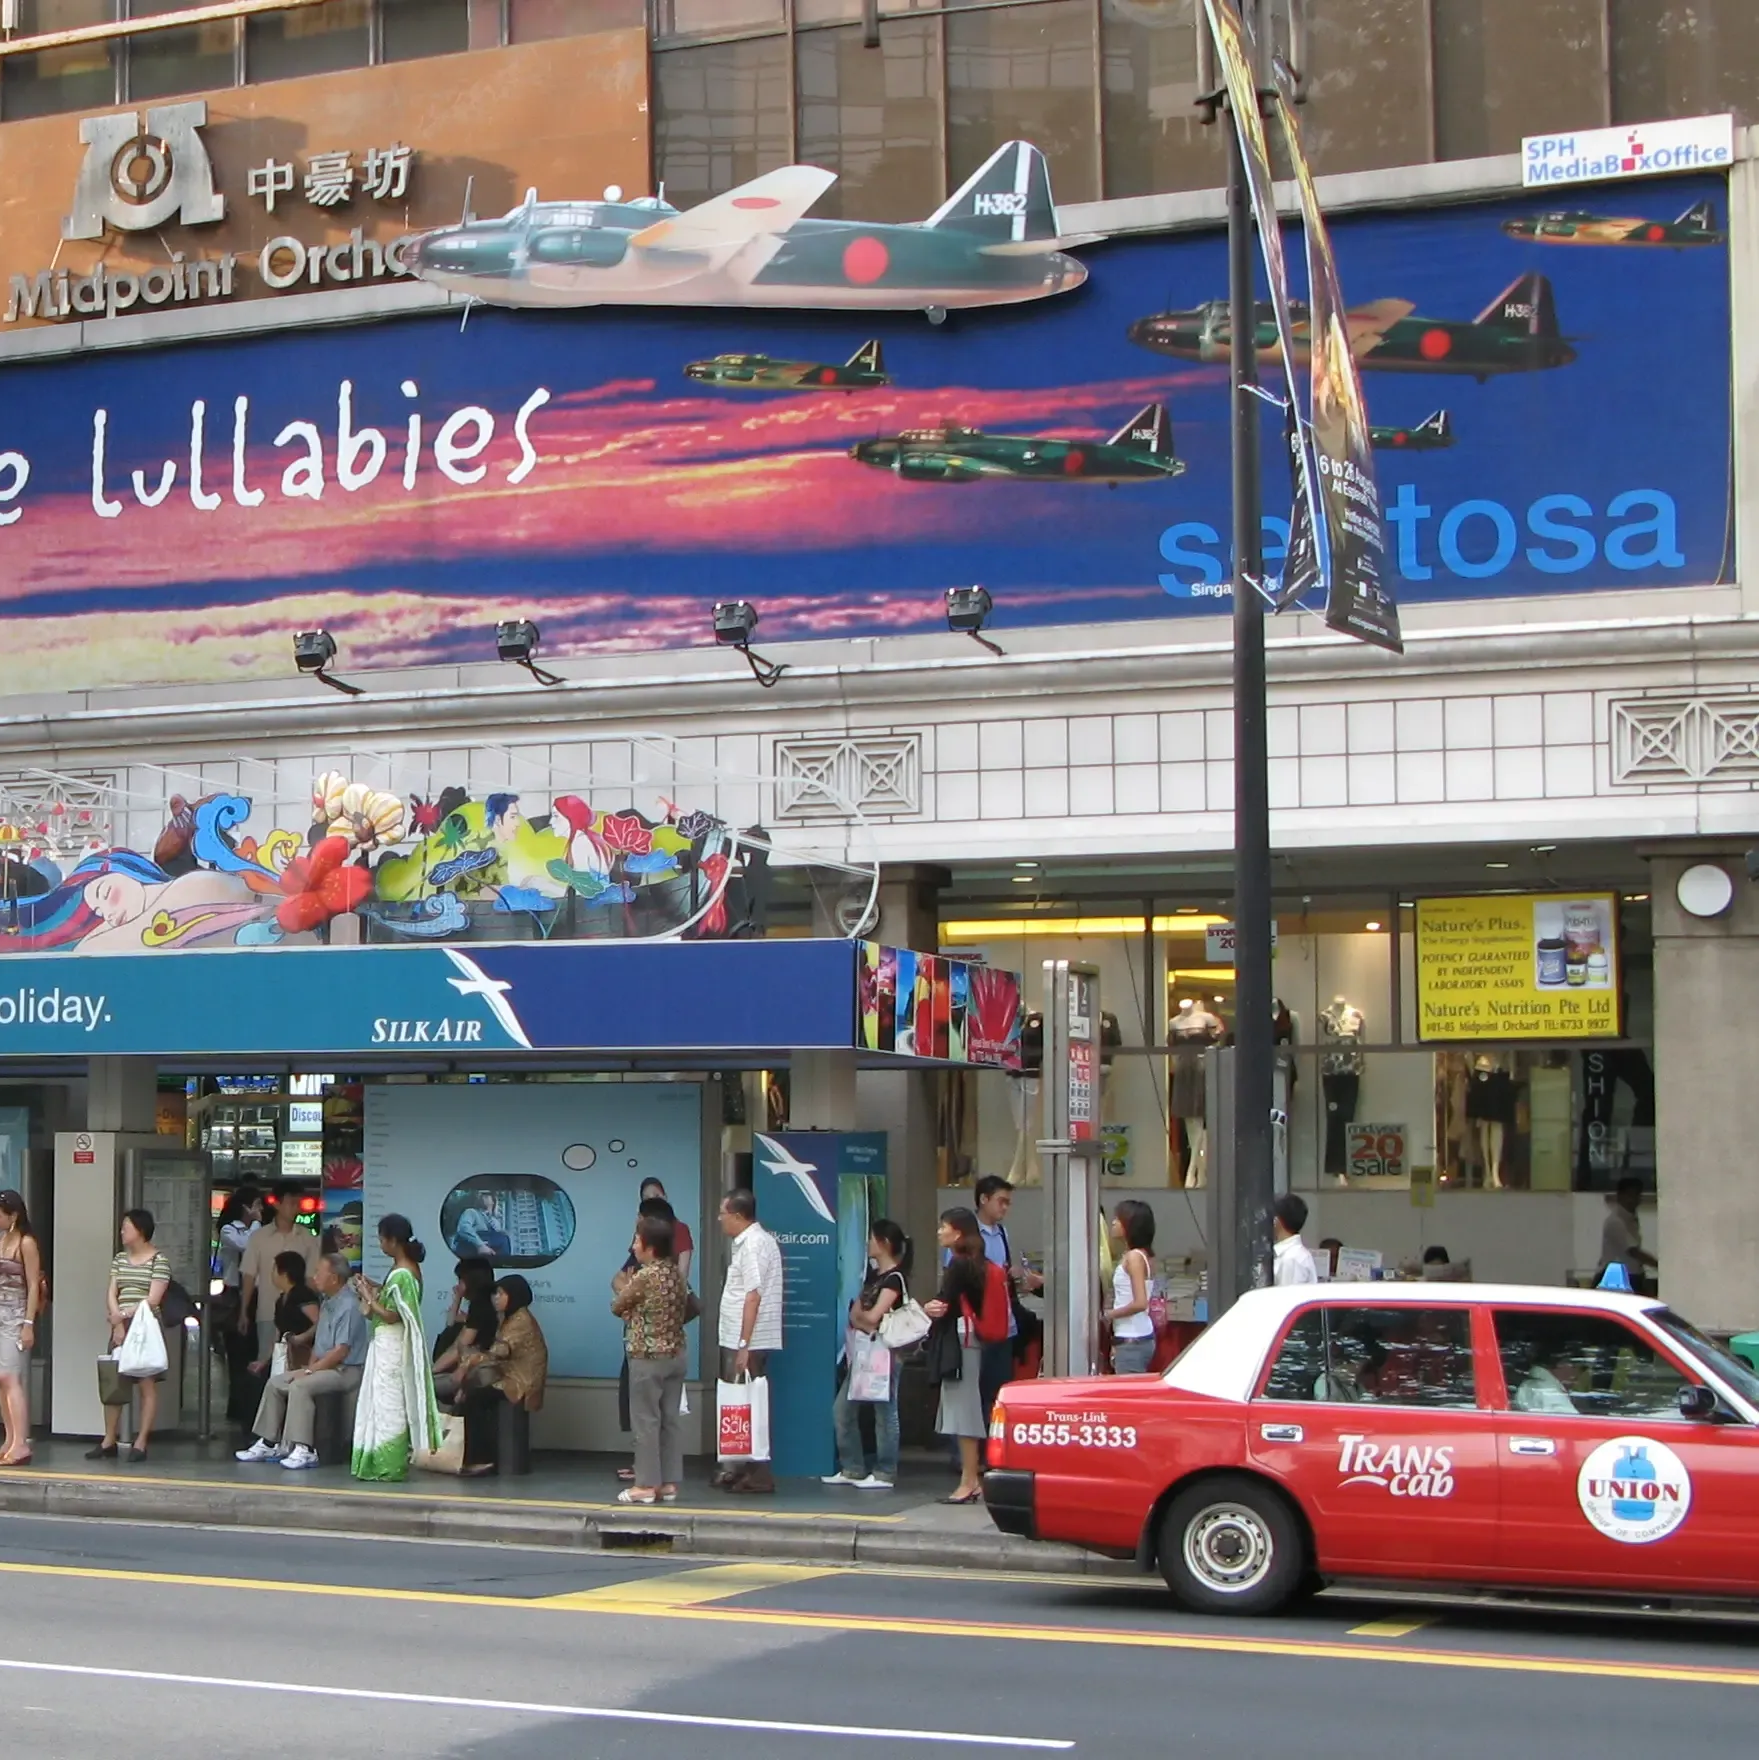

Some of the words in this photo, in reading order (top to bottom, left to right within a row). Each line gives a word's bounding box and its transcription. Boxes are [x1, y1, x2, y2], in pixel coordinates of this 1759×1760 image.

[1527, 138, 1575, 161] SPH
[248, 142, 416, 214] 中豪坊
[3, 251, 237, 323] Midpoint
[92, 379, 550, 518] lullabies
[1319, 455, 1329, 475] 6
[1159, 484, 1686, 598] stosa
[1422, 917, 1484, 932] Nature's
[1422, 952, 1464, 964] POTENCY
[1468, 950, 1531, 963] GUARANTEED
[1437, 967, 1448, 977] BY
[1452, 964, 1515, 977] INDEPENDENT
[1428, 979, 1488, 991] LABORATORY
[1494, 977, 1525, 989] ASSAYS
[1424, 1000, 1481, 1018] Nature's
[1488, 999, 1552, 1017] Nutrition
[1558, 998, 1582, 1015] Pte
[1588, 997, 1611, 1015] Ltd
[1502, 1017, 1540, 1032] Orchard
[1351, 1157, 1402, 1176] sale
[721, 1416, 750, 1434] Sale
[1045, 1409, 1108, 1424] Trans-Link
[1013, 1422, 1138, 1449] 6555-3333
[1336, 1433, 1455, 1474] TRANS
[1388, 1468, 1455, 1498] cab
[1587, 1478, 1681, 1502] UNION
